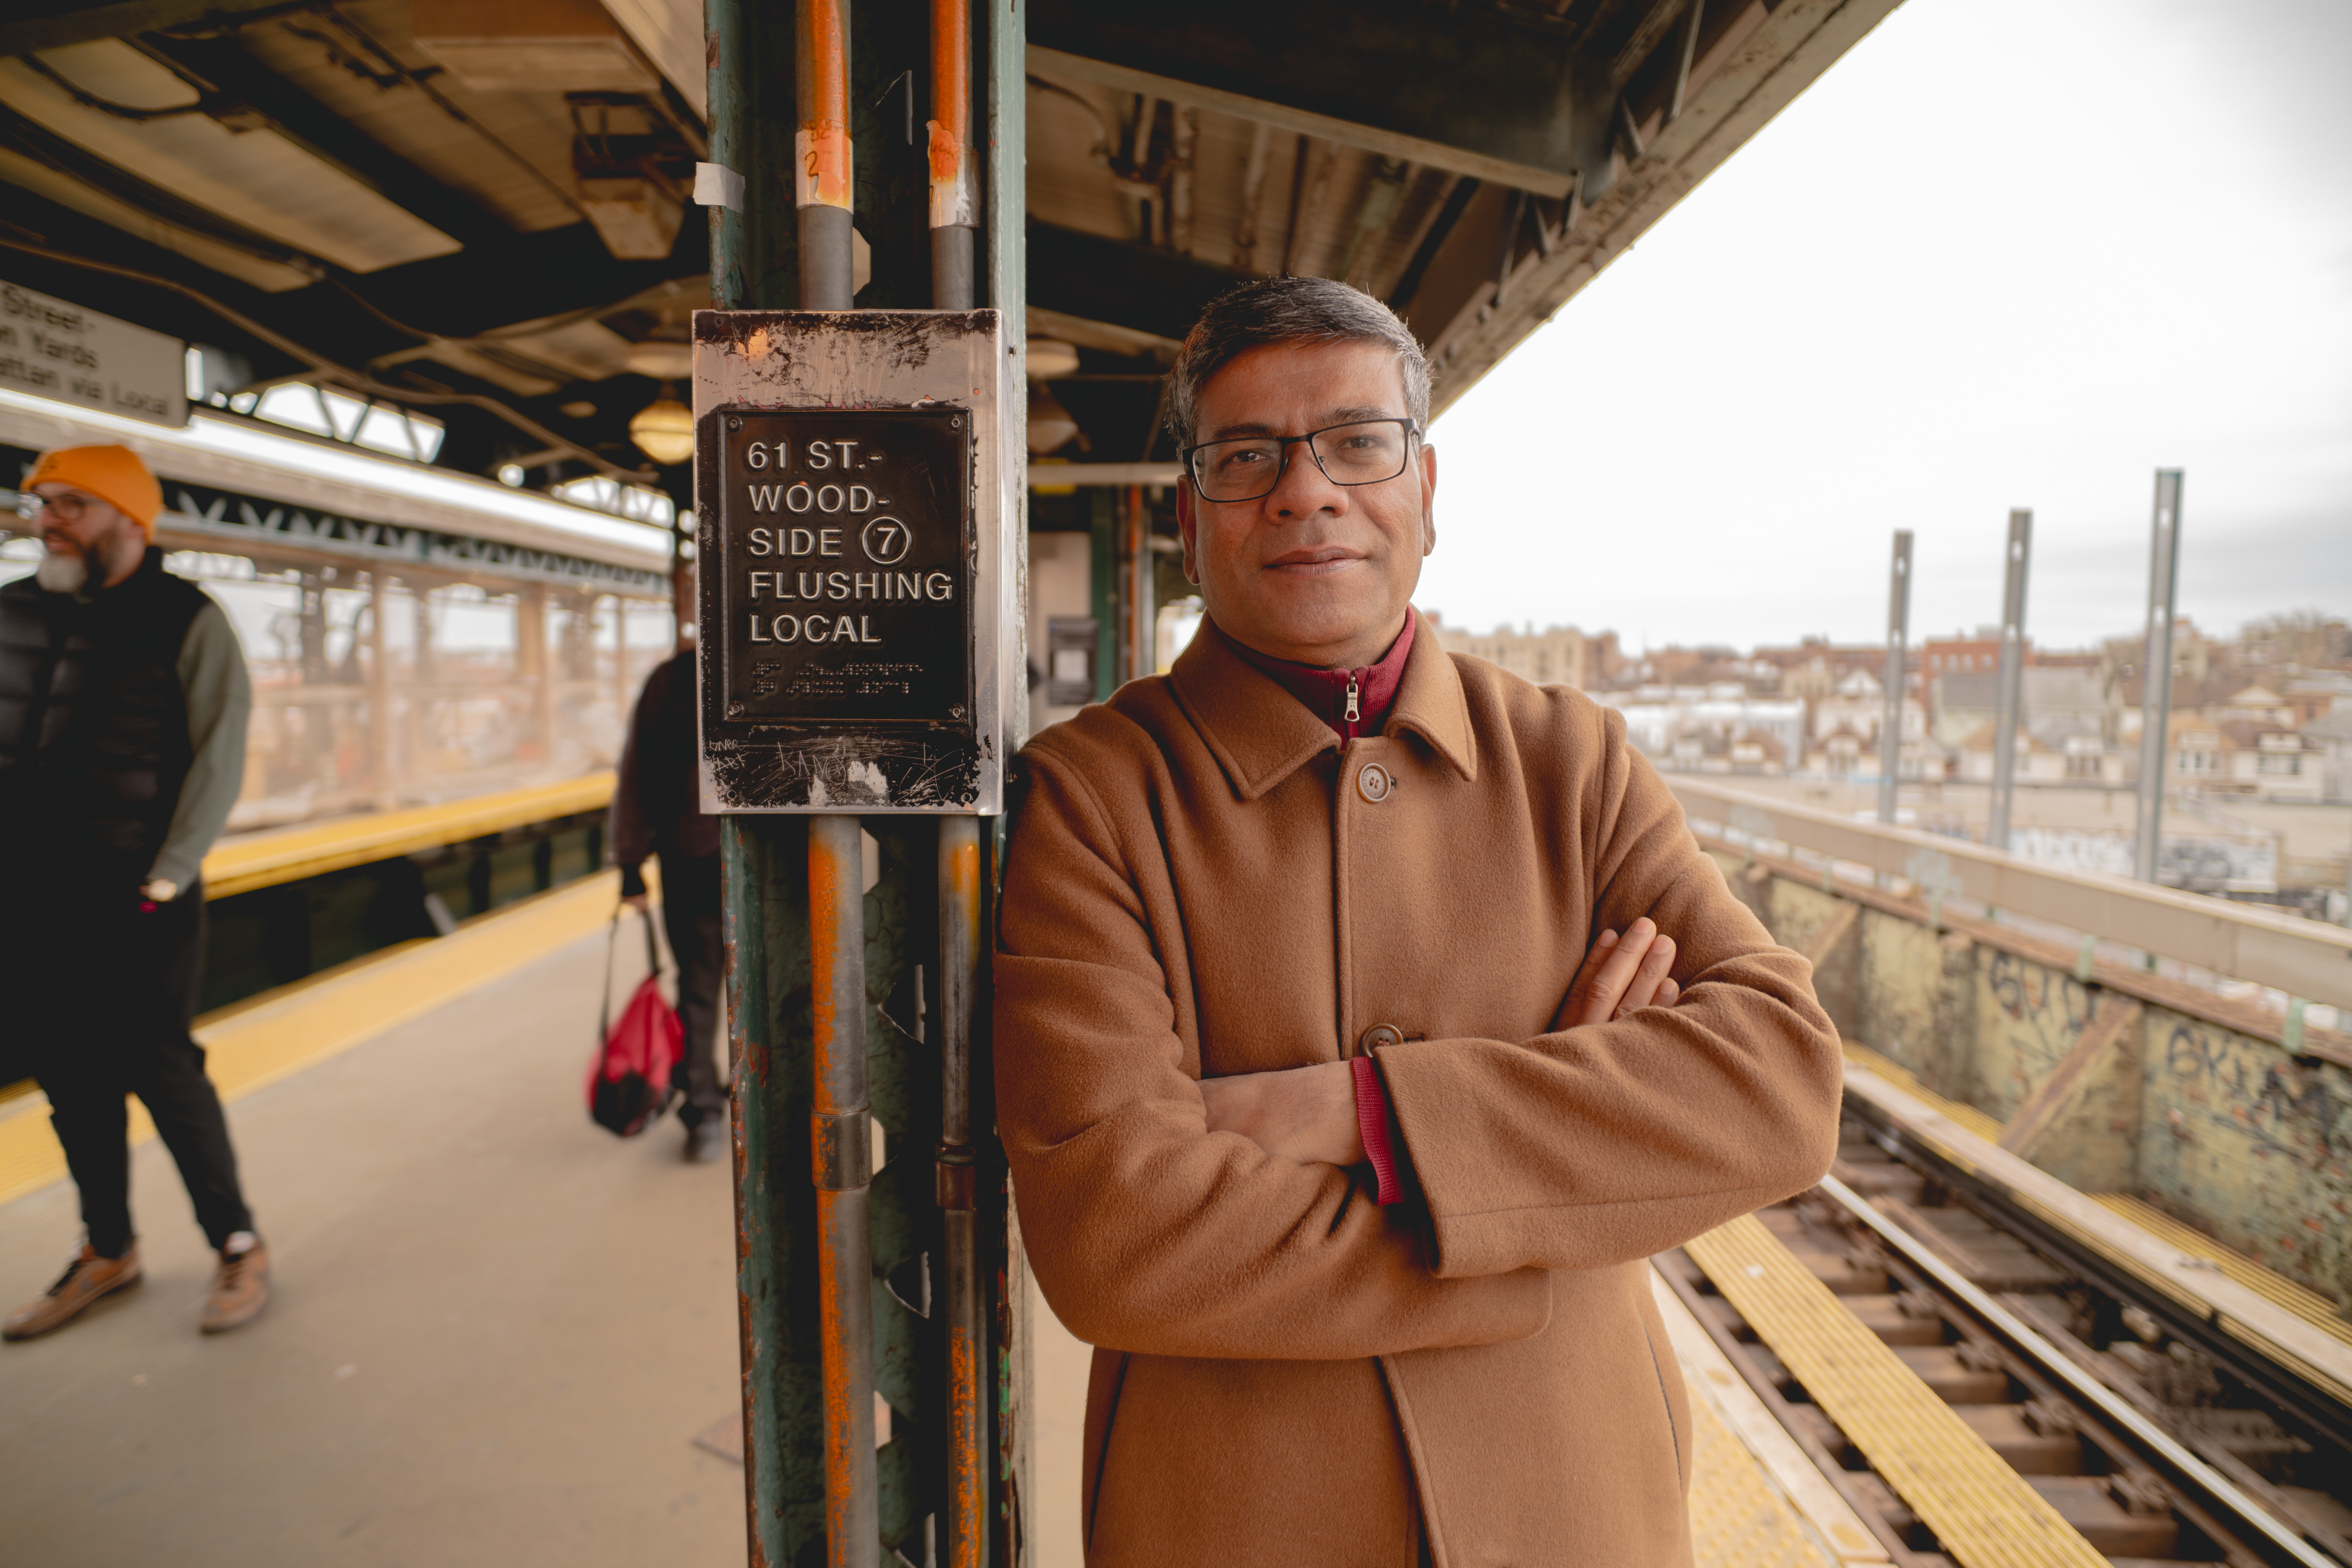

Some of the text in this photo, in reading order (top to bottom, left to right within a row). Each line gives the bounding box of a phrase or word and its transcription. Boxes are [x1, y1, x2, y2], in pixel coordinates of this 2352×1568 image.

[29, 326, 99, 369] Yards
[69, 377, 105, 400] via
[112, 380, 171, 415] Local
[748, 442, 787, 470] 61
[748, 483, 890, 513] WOOD-
[749, 526, 899, 557] SIDE 7
[749, 571, 953, 601] FLUSHING
[750, 613, 882, 644] LOCAL
[1364, 769, 1375, 778] HAAN
